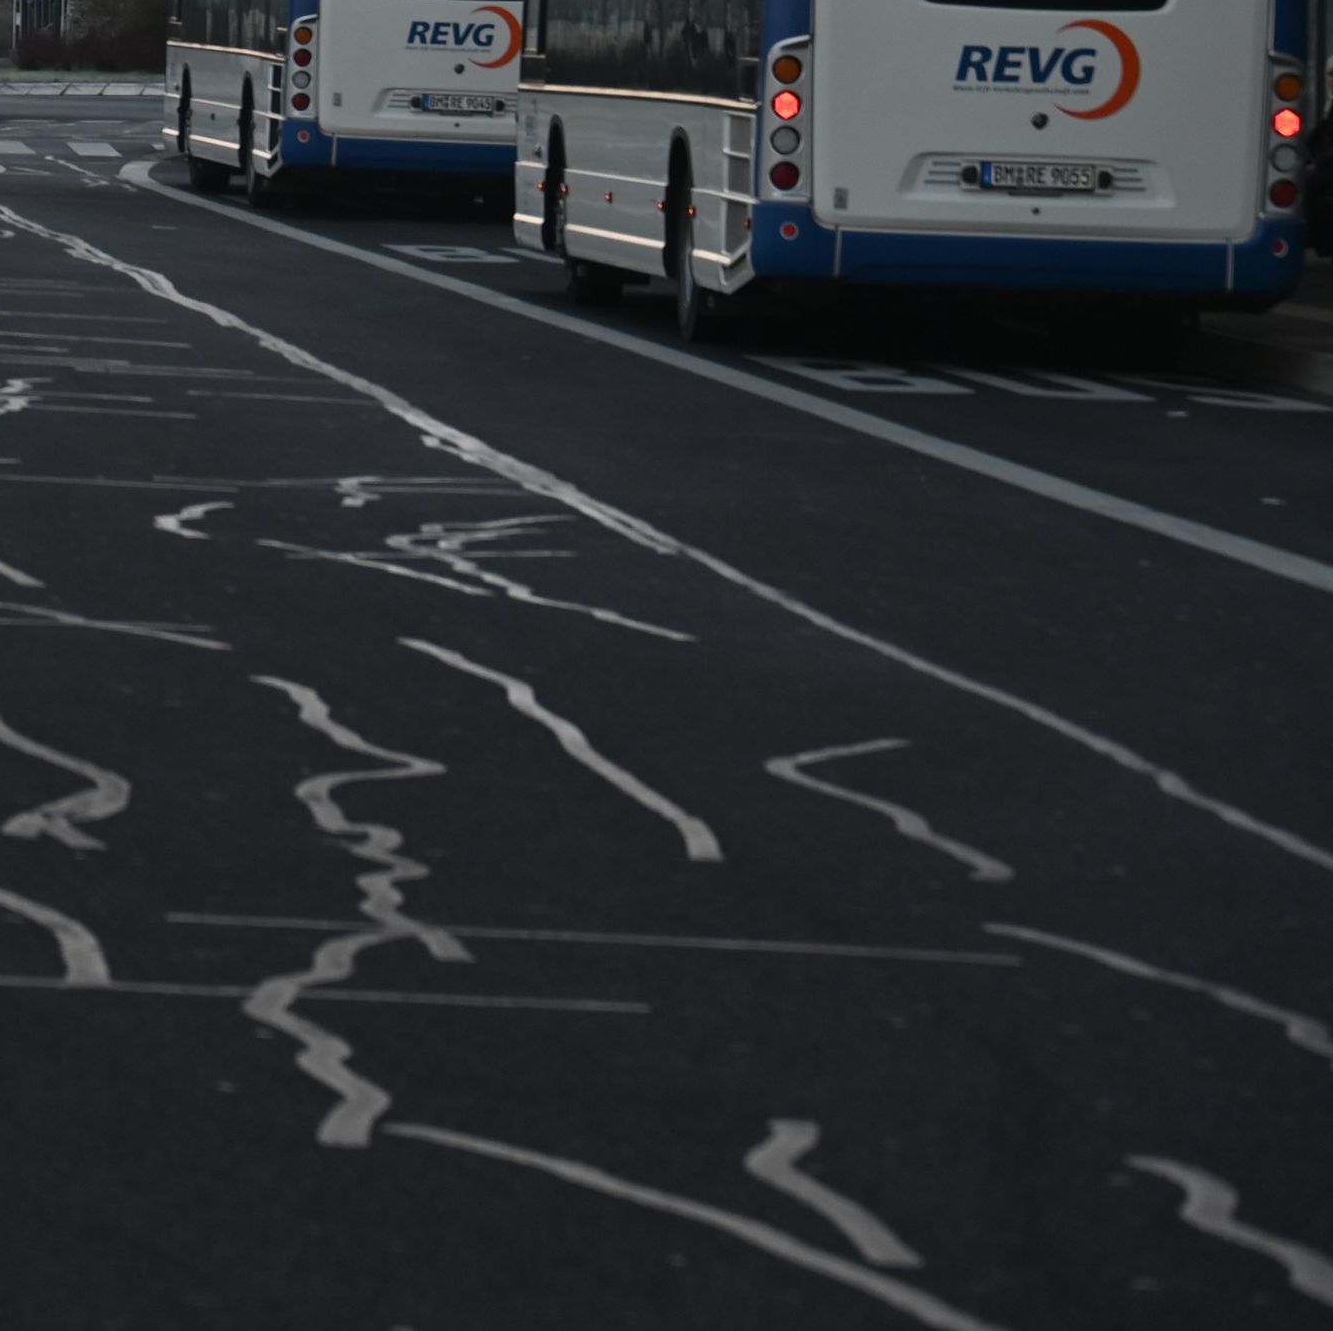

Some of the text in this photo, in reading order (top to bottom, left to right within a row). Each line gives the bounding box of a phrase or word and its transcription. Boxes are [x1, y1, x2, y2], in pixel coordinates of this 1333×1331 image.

[407, 21, 495, 47] REVG
[955, 45, 1097, 85] REVG
[994, 166, 1014, 183] BM
[1027, 167, 1045, 184] RE
